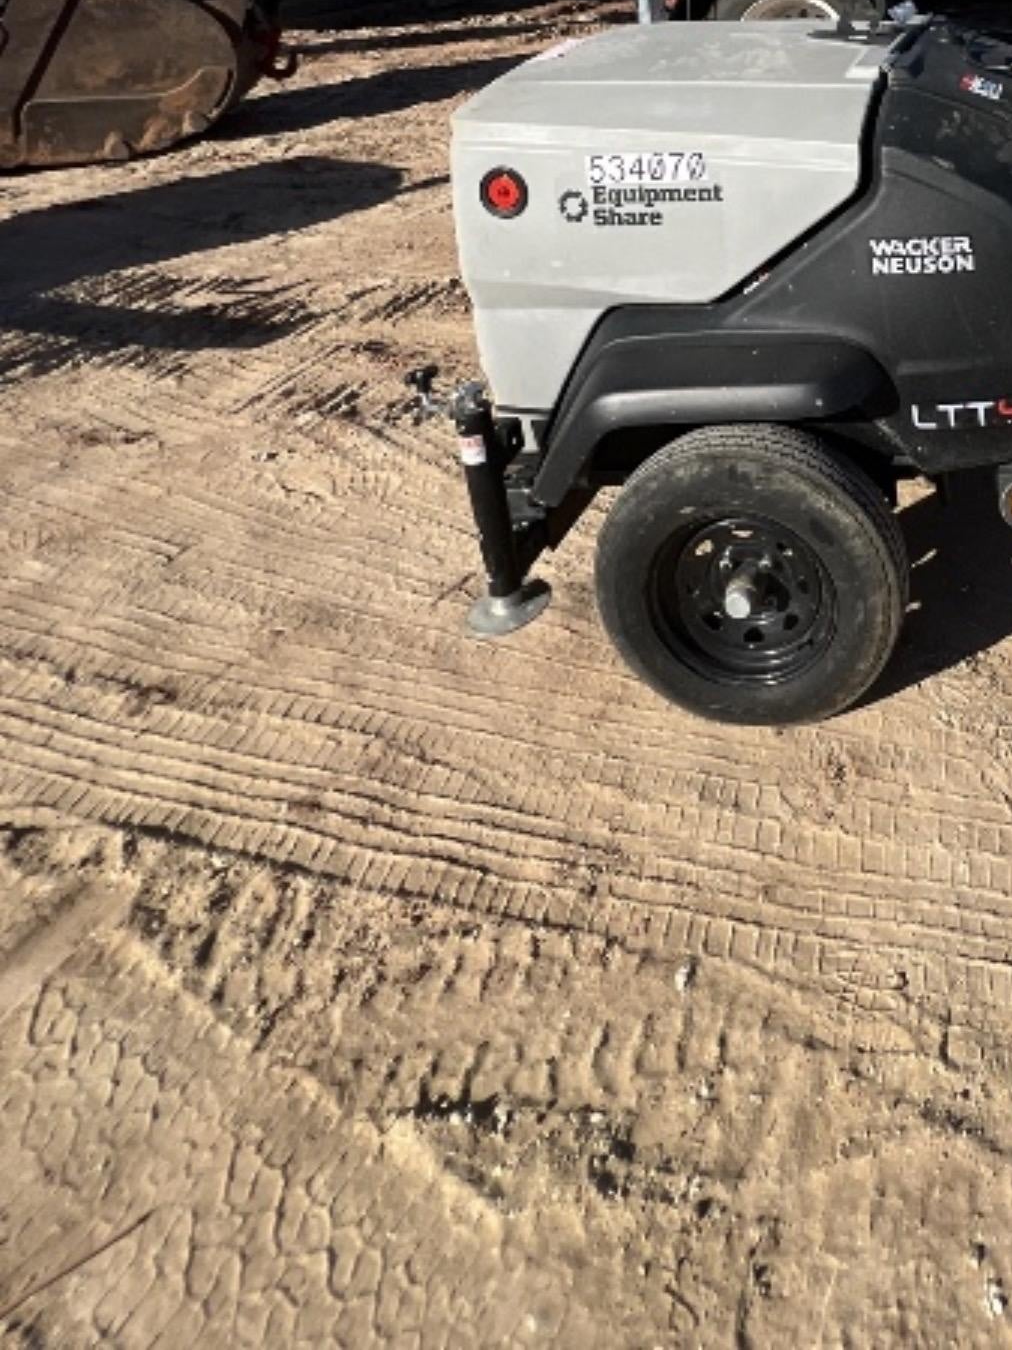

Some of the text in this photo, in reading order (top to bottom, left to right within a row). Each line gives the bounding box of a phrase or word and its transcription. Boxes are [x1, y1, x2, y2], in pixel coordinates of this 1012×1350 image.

[589, 152, 706, 184] 534070
[592, 184, 724, 207] Equipment
[593, 209, 663, 226] Share
[869, 236, 973, 255] WACKER
[872, 254, 975, 274] NEUSON
